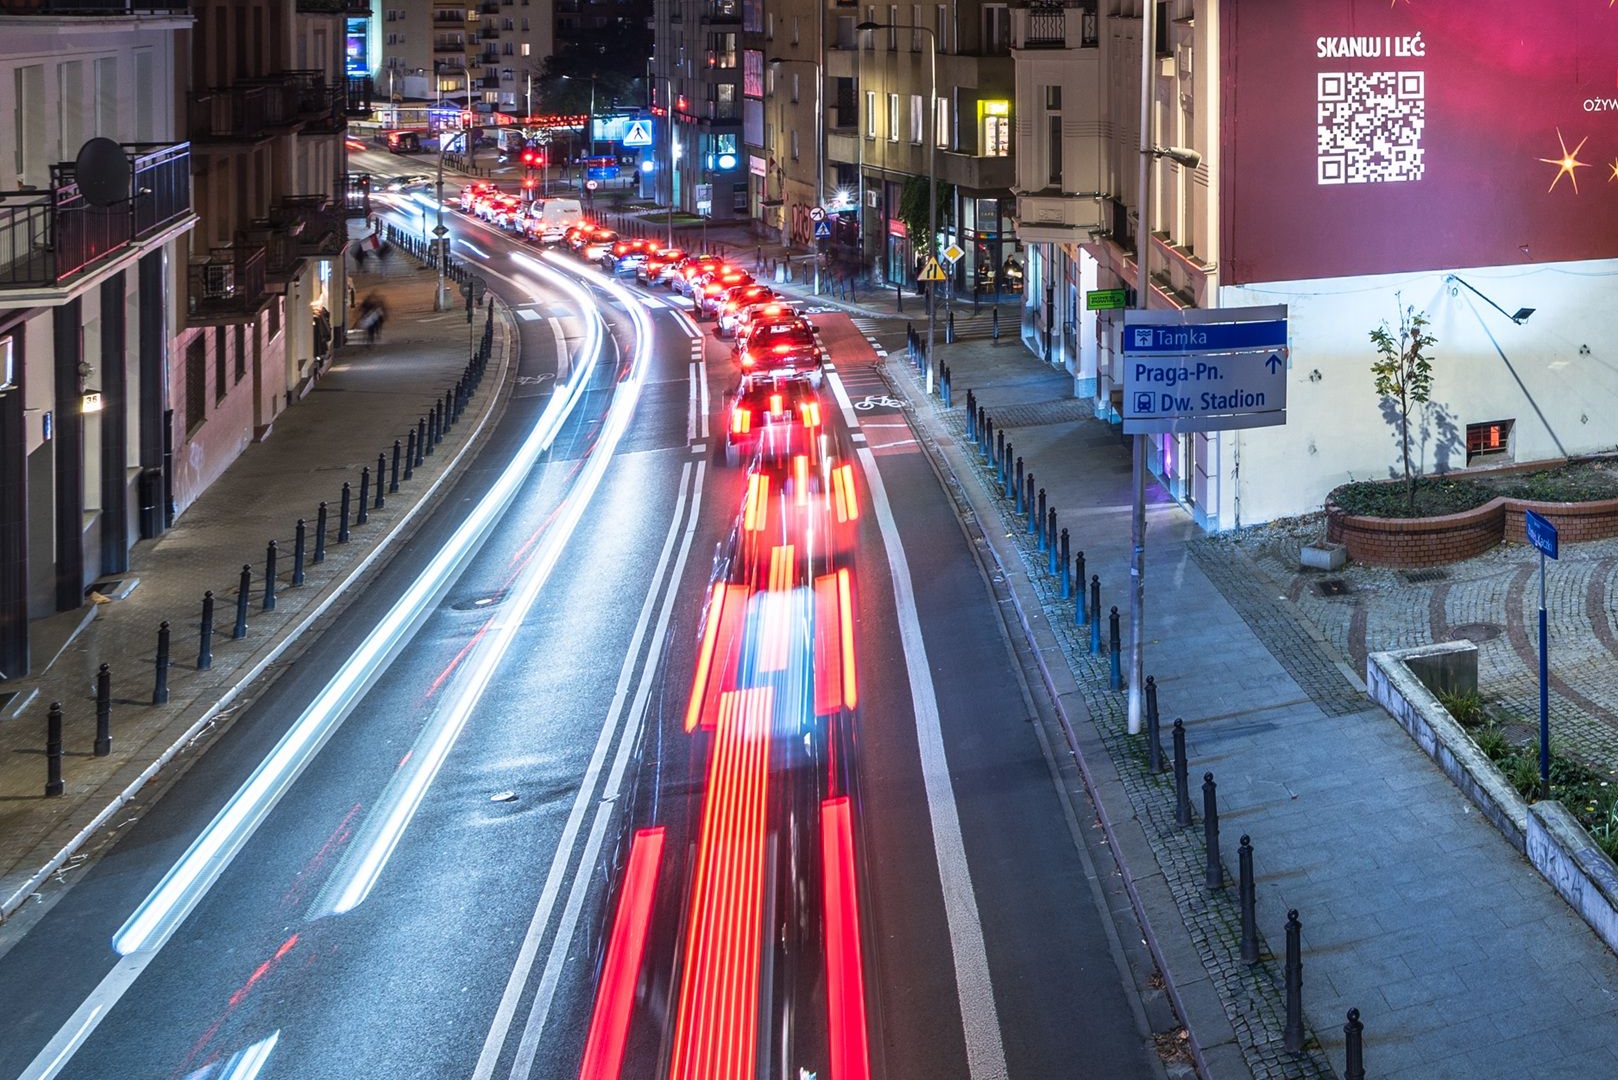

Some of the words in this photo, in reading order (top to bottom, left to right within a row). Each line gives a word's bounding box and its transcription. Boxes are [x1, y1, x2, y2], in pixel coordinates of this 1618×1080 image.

[1316, 36, 1381, 58] SKANUJ
[1385, 36, 1391, 57] I
[1156, 330, 1207, 346] Tamka
[1135, 363, 1224, 387] Praga-Pn.
[1161, 394, 1194, 412] Dw.
[1200, 389, 1265, 411] Stadion
